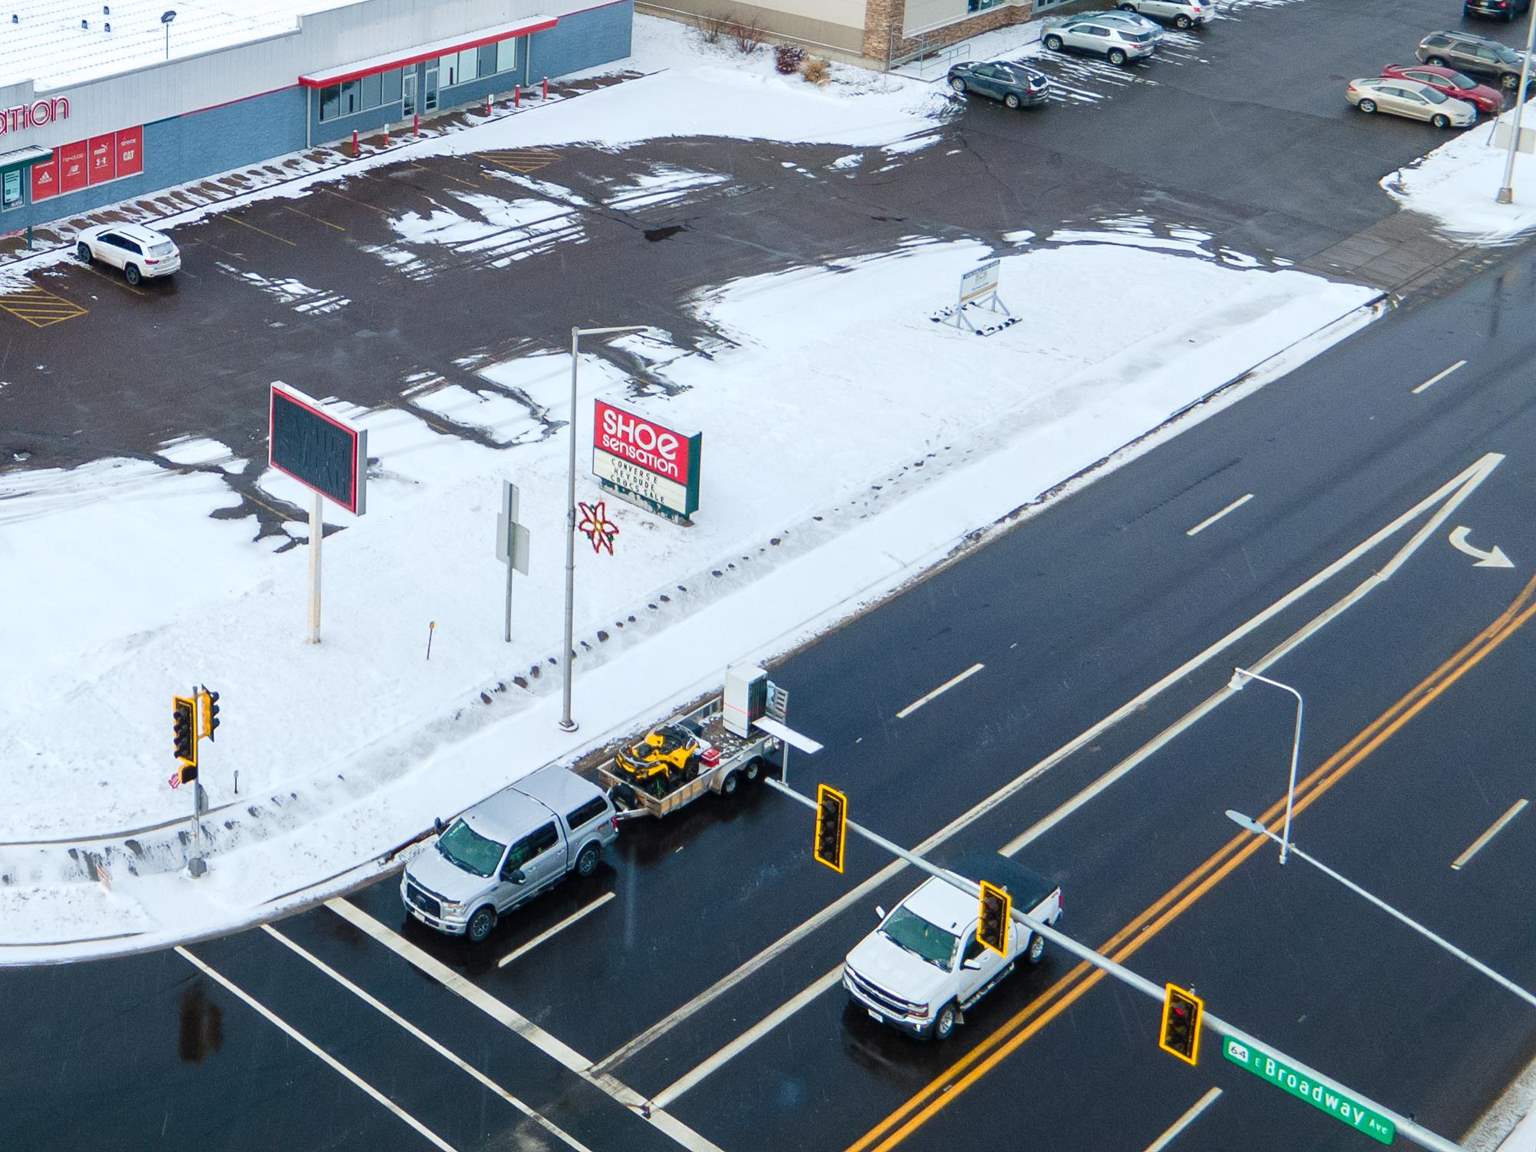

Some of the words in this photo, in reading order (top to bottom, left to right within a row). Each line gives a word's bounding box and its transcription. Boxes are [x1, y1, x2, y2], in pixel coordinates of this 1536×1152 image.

[123, 150, 134, 161] CAT
[611, 458, 658, 484] CONVERSE
[610, 474, 640, 493] CROCS
[644, 489, 665, 503] SALE
[1230, 1045, 1247, 1060] 64
[1254, 1057, 1261, 1068] E
[1265, 1058, 1365, 1125] Broadway
[1368, 1118, 1389, 1135] Ave
